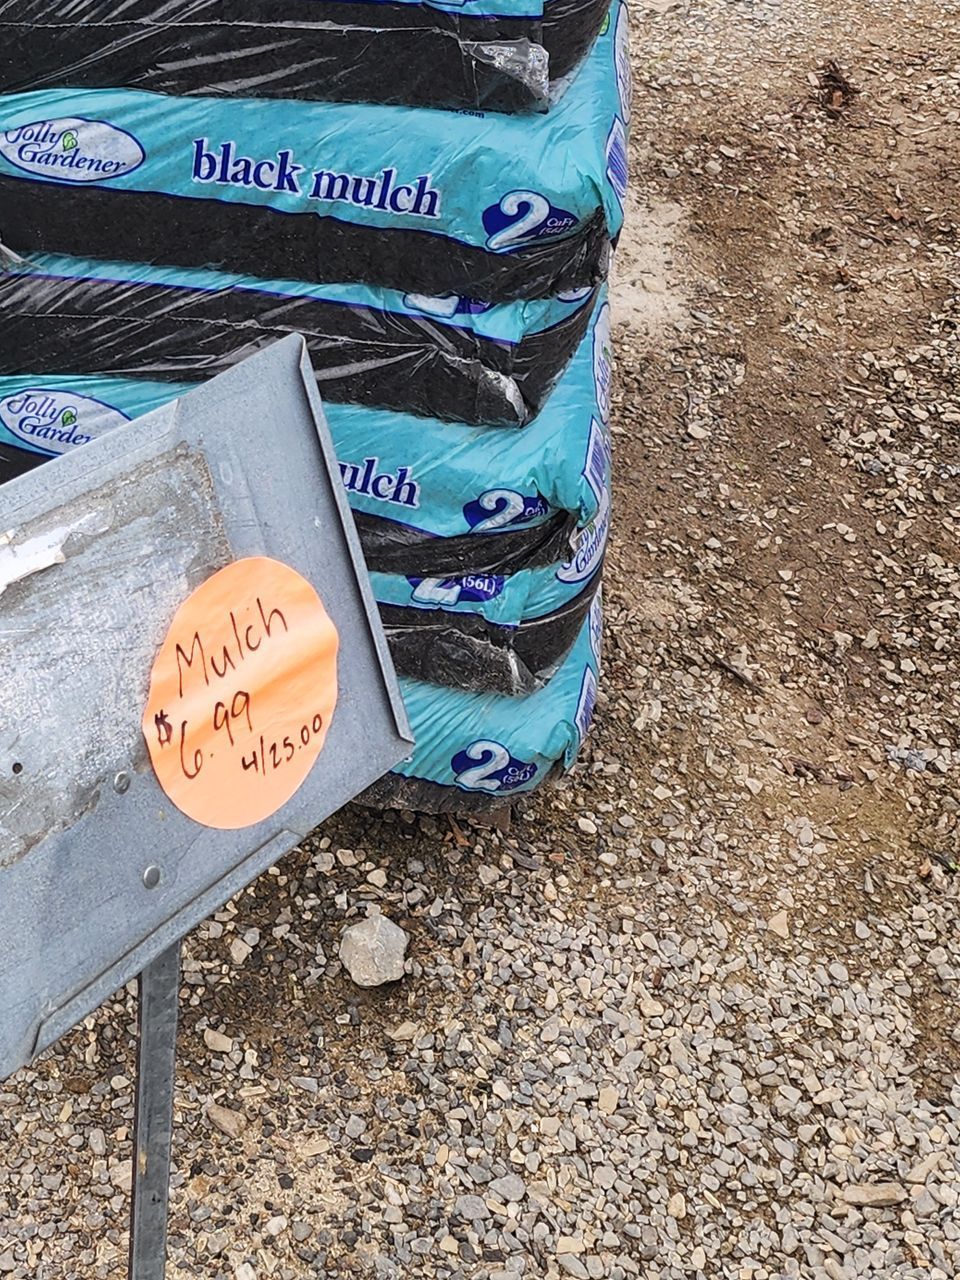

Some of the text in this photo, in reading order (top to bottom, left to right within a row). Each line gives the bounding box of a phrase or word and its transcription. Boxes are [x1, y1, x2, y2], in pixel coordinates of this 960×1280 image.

[4, 122, 64, 146] Jolly
[17, 141, 127, 174] Gardener
[191, 137, 441, 218] black mulch
[485, 189, 551, 252] 2
[7, 393, 61, 422] Jolly
[339, 458, 419, 507] ulch
[461, 574, 497, 595] (56L)
[175, 597, 289, 698] Mulch
[154, 690, 253, 780] $6.99
[241, 713, 323, 776] 4/25.00
[453, 739, 511, 792] 2
